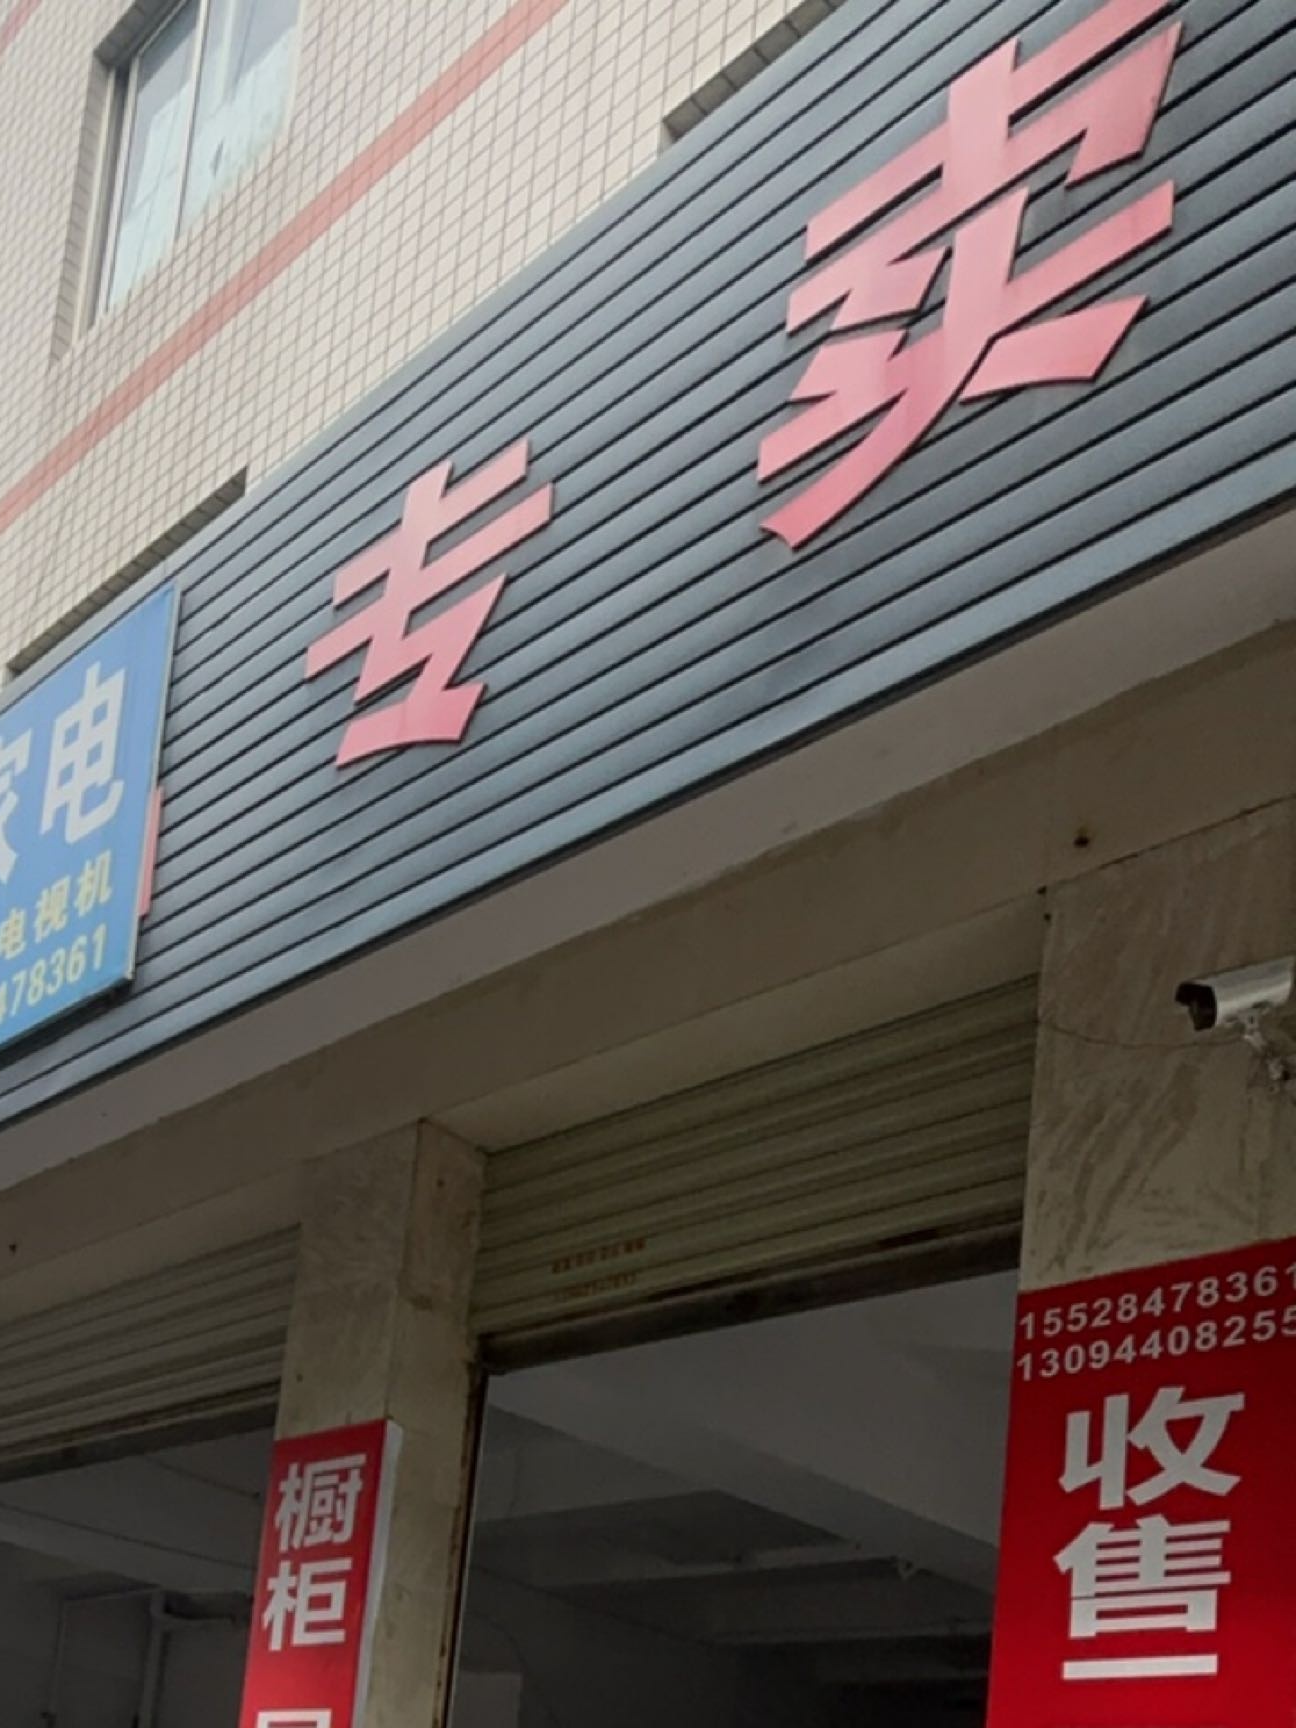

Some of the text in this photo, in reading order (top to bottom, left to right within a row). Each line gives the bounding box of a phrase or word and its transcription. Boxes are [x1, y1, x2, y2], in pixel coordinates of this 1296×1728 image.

[303, 0, 1185, 769] 专卖
[1016, 1303, 1296, 1382] 13094408255
[1019, 1262, 1296, 1340] 15528478361
[262, 1451, 367, 1652] 橱柜
